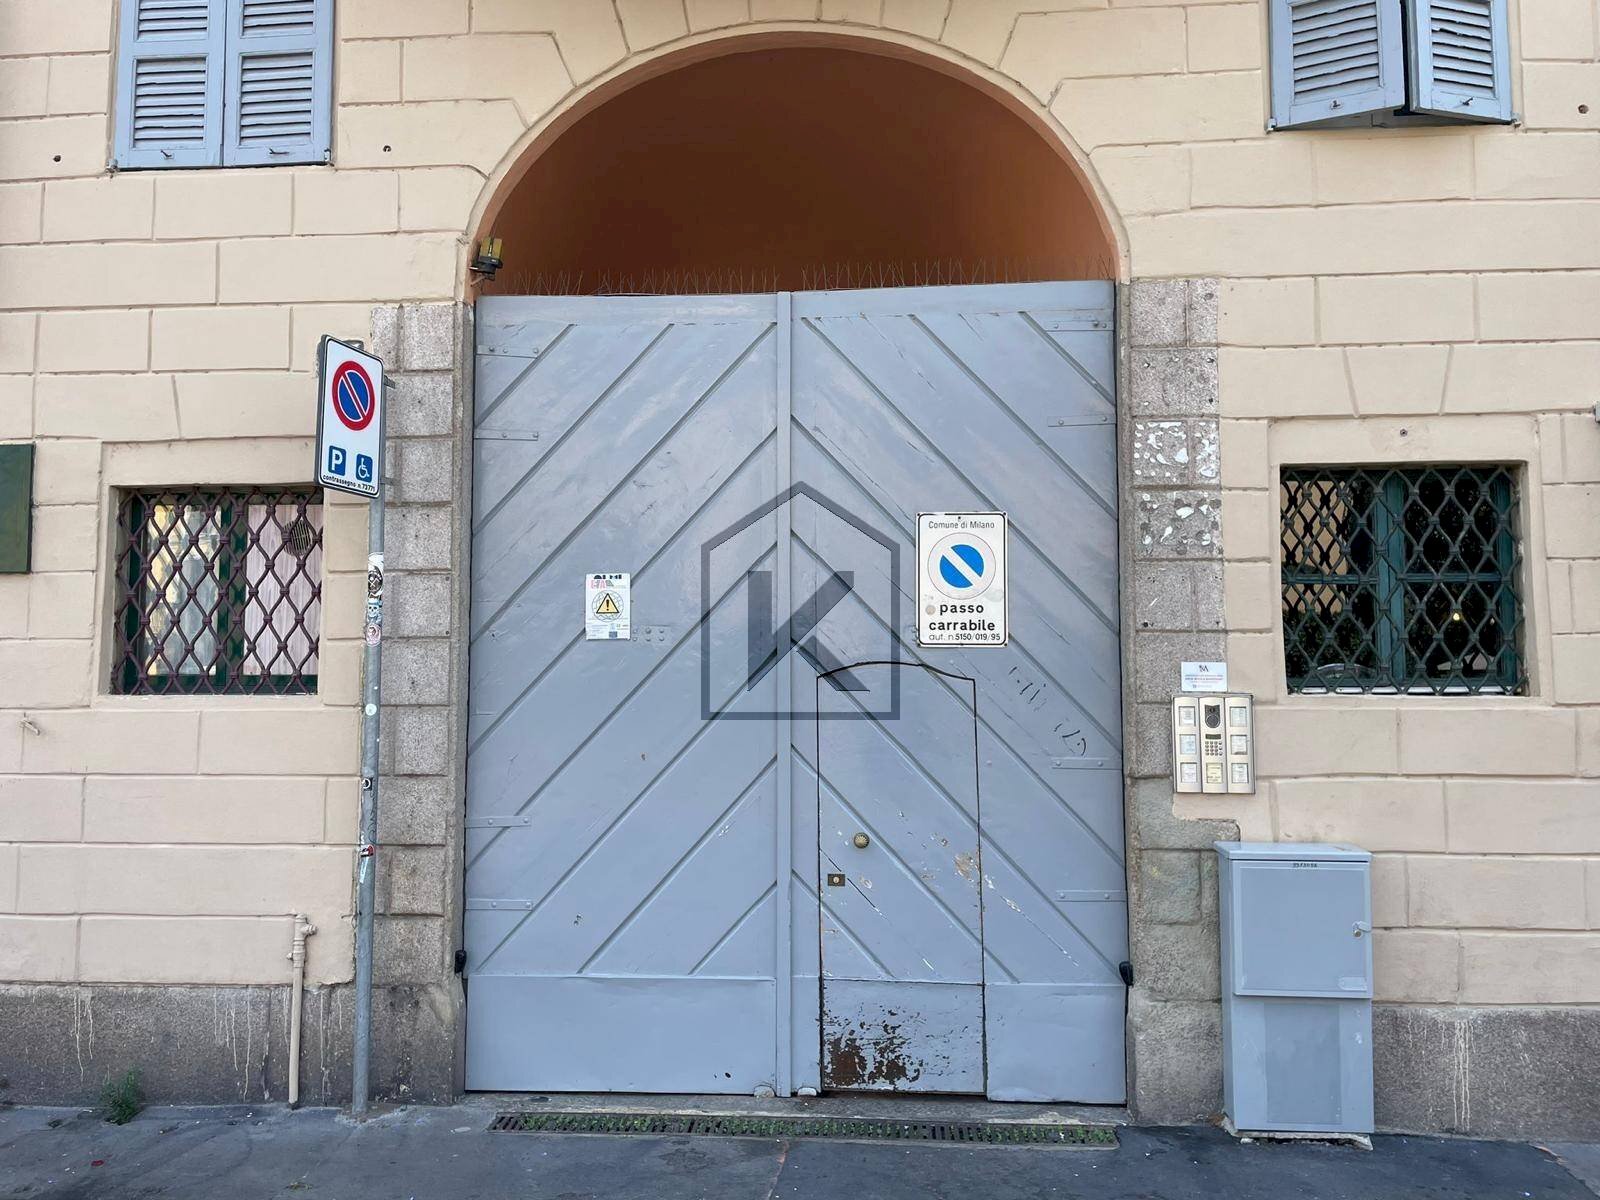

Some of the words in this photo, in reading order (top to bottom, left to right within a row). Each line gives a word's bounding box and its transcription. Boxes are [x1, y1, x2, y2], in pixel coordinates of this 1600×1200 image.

[331, 448, 344, 471] P
[928, 521, 959, 529] Comune
[960, 520, 968, 529] di
[969, 521, 995, 529] Milano
[939, 603, 985, 616] passo
[928, 619, 996, 631] carrabile
